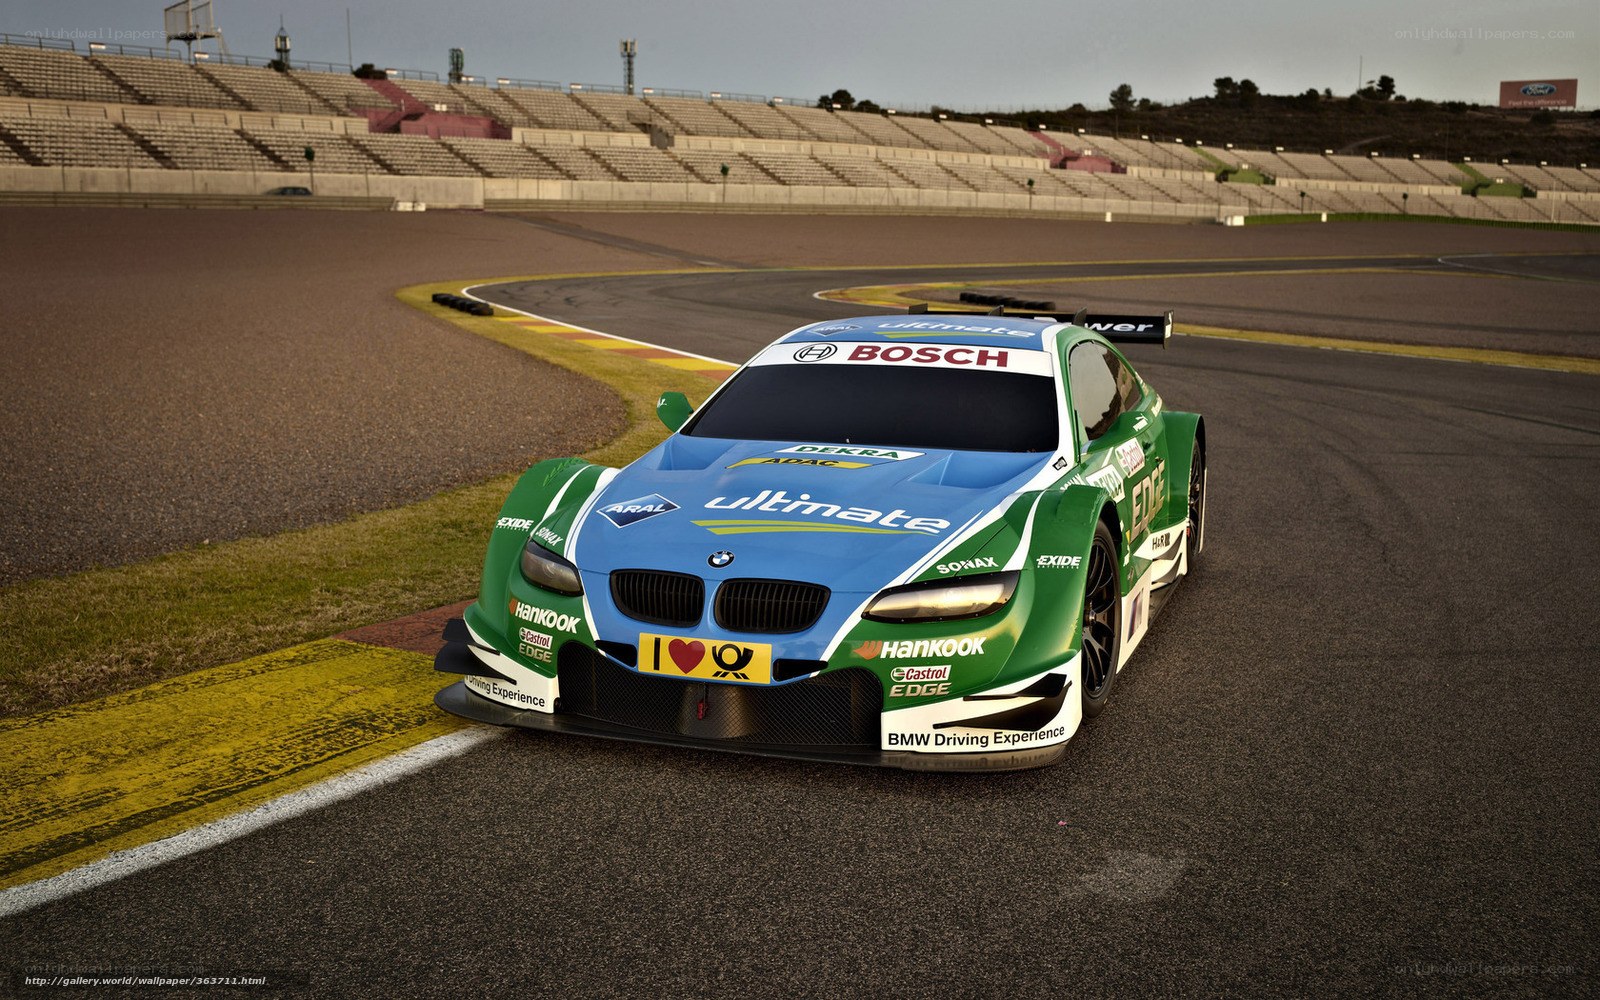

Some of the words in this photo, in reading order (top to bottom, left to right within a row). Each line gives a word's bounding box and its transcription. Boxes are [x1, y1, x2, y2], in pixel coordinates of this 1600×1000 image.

[877, 321, 1036, 338] ultimate
[848, 345, 1008, 367] BOSCH
[790, 445, 900, 459] DEKRA
[761, 457, 840, 467] ADAC
[605, 504, 666, 514] ARAL
[704, 489, 951, 533] ultimate
[497, 517, 534, 529] EXIDE
[536, 527, 563, 546] SONAX
[937, 557, 998, 574] SONAX
[1036, 555, 1082, 566] EXIDE
[525, 631, 551, 648] Castrol
[519, 643, 553, 662] EDGE
[654, 637, 661, 671] I
[905, 667, 948, 682] Castrol
[491, 682, 546, 708] Experience
[889, 683, 952, 697] EDGE
[888, 733, 931, 746] BMW
[934, 733, 990, 748] Driving
[993, 725, 1066, 745] Experience
